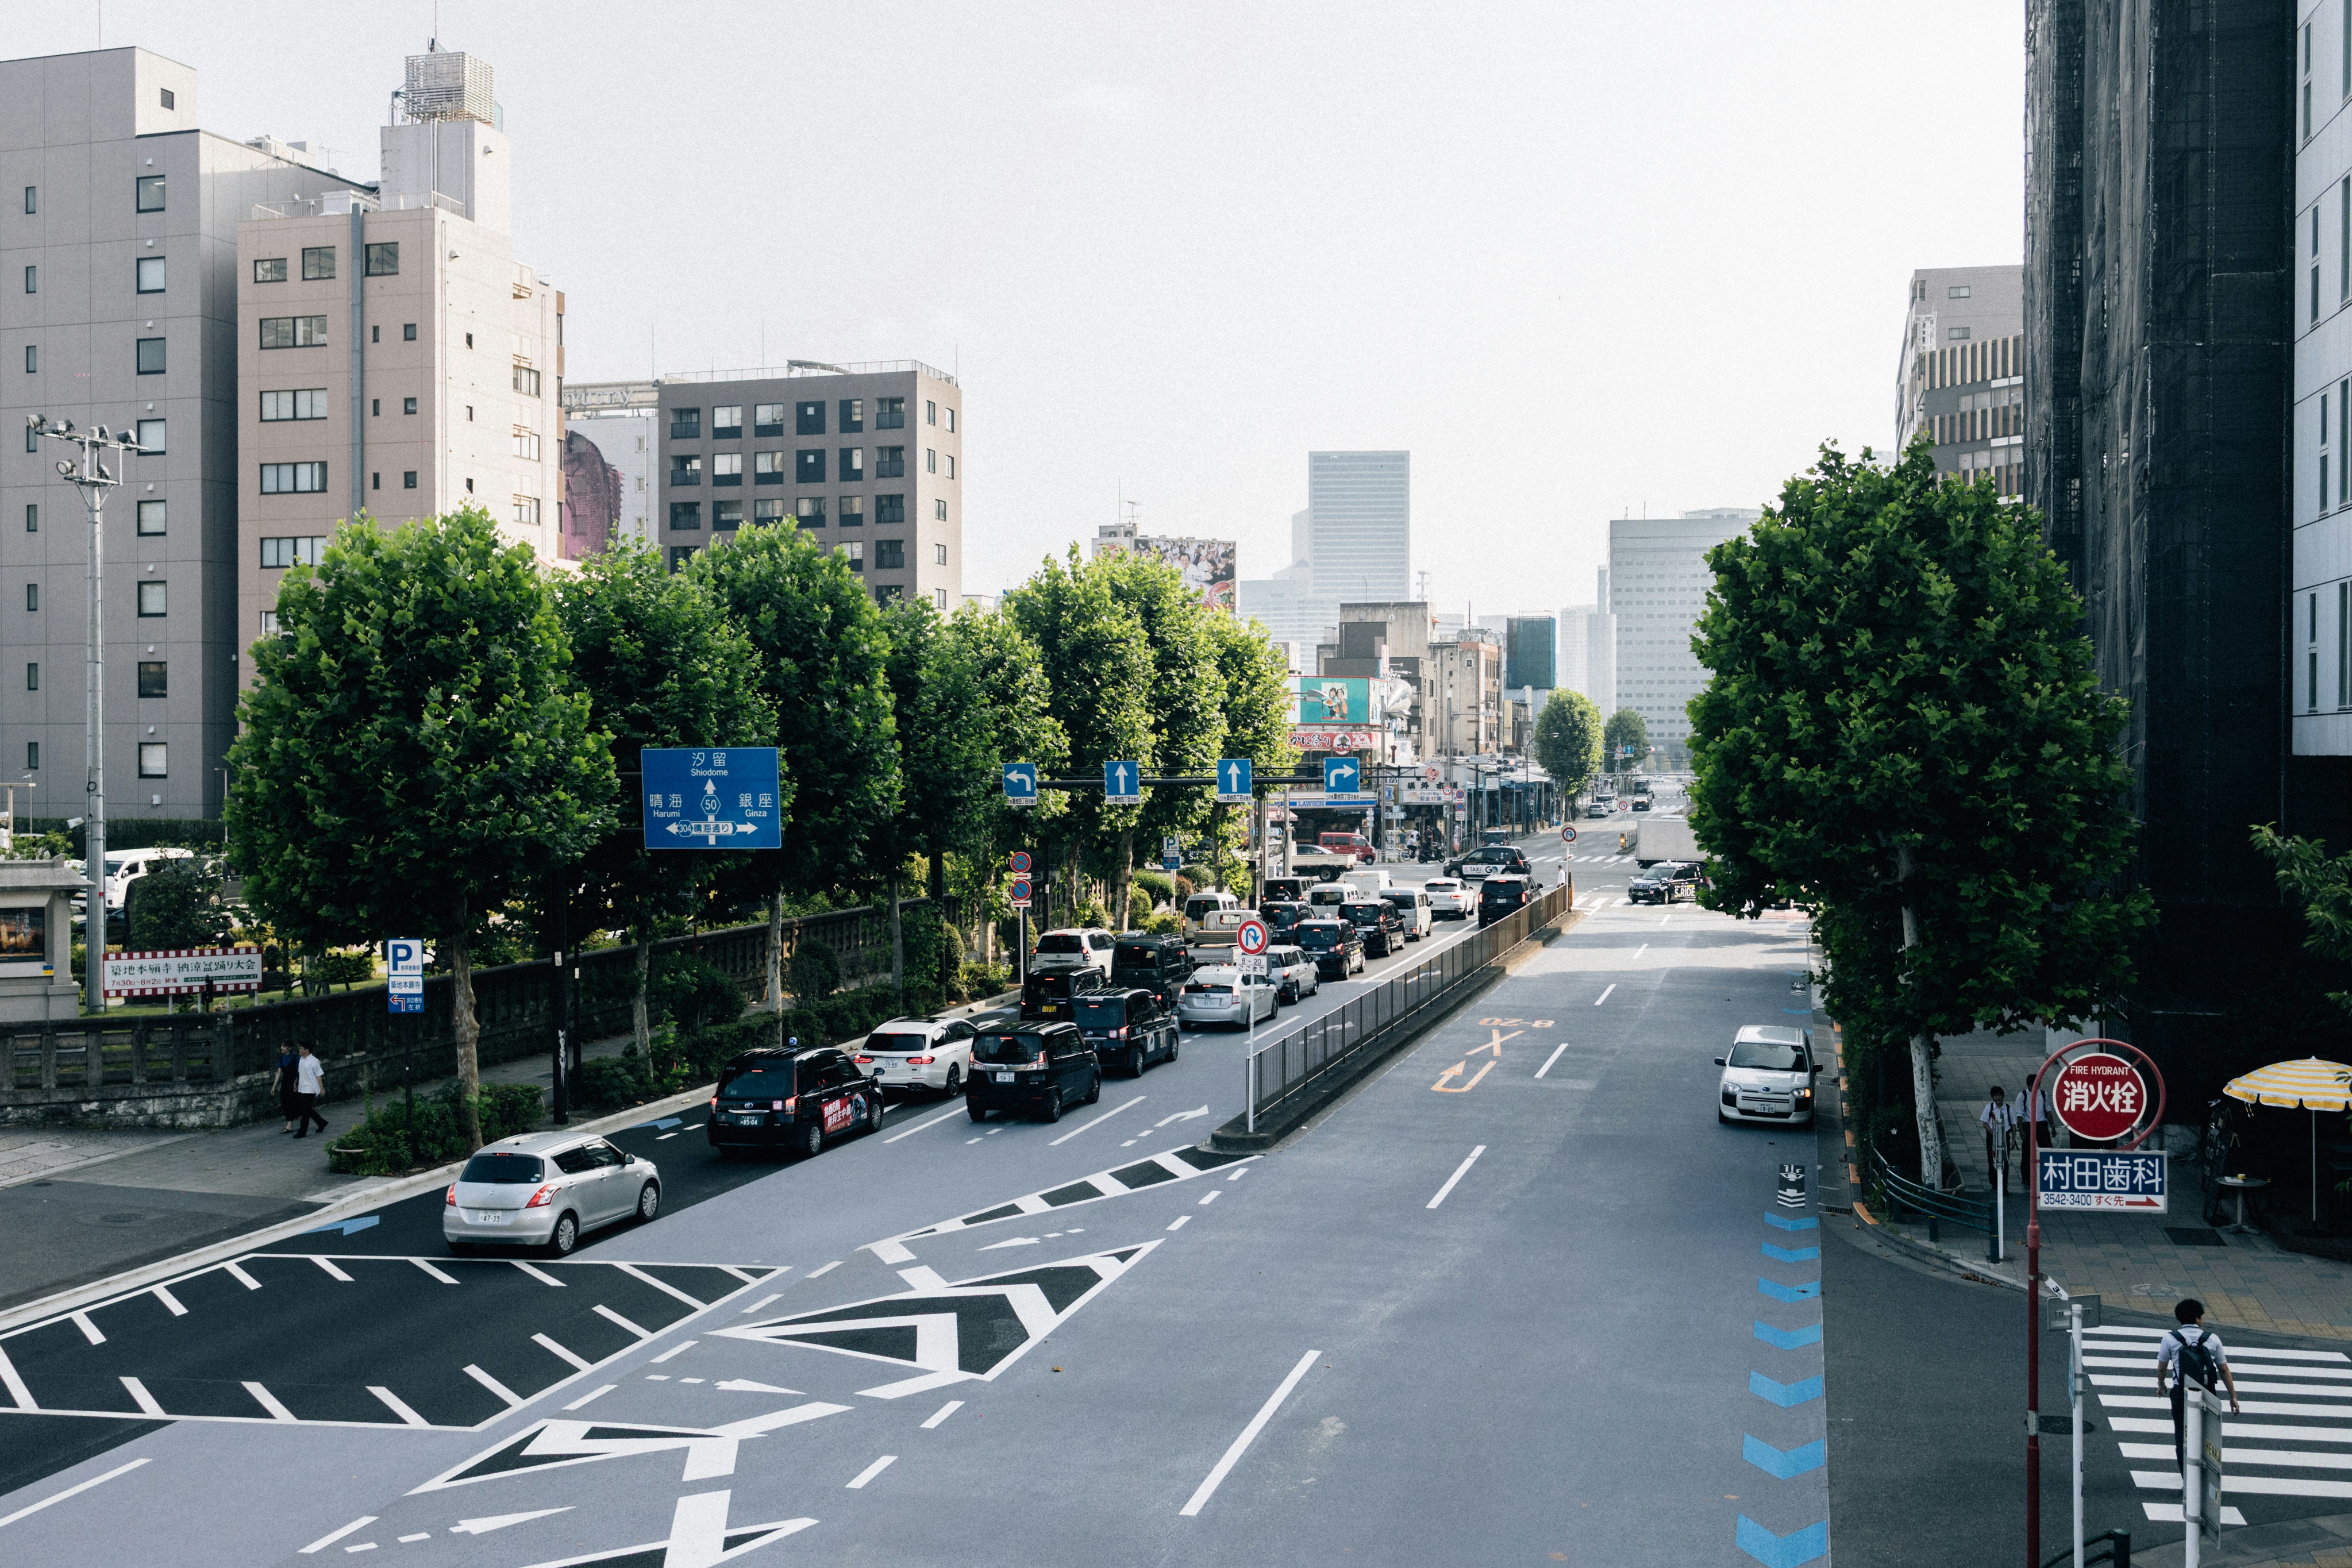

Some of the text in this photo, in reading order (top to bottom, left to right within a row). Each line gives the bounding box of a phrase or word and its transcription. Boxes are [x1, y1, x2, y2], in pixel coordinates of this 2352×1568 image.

[1291, 733, 1330, 748] かに祭り
[692, 752, 726, 766] 汐留
[691, 768, 728, 776] Shiodome
[649, 793, 683, 808] 晴海
[705, 799, 717, 810] 50
[739, 793, 773, 808] 銀座
[653, 810, 680, 818] Harumi
[745, 809, 767, 817] Ginza
[679, 824, 692, 833] 304
[694, 824, 729, 833] 晴海通り
[392, 944, 413, 971] P
[111, 959, 256, 976] 築地本願寺 納涼盆踊り大会
[391, 981, 421, 989] 築地本願寺
[2070, 1065, 2130, 1076] FIRE HYDRANT
[2063, 1080, 2138, 1113] 消火栓
[827, 1103, 852, 1128] 無料生中継
[2043, 1155, 2162, 1193] 村田歯科
[2043, 1193, 2124, 1207] 3542-3400 すぐ先
[2052, 1285, 2062, 1297] 3m
